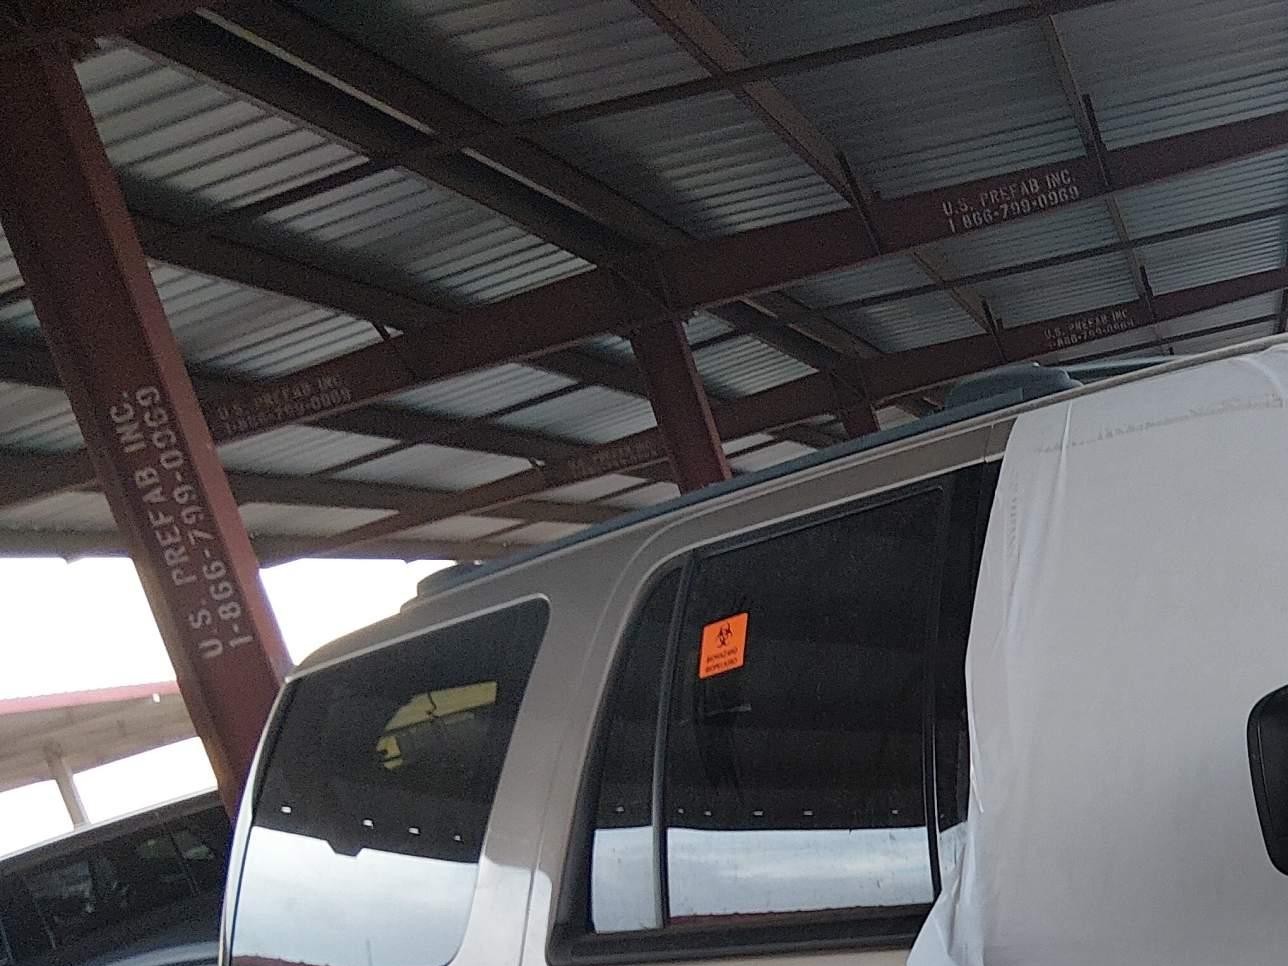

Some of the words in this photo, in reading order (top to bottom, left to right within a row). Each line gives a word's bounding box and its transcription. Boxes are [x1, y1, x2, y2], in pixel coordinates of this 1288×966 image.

[943, 198, 974, 217] U.S.
[981, 178, 1041, 208] PREFAB
[110, 390, 147, 454] INC.
[135, 466, 198, 586] PREFAB
[136, 385, 254, 648] 1-866-799-0969
[188, 601, 225, 659] U.S.
